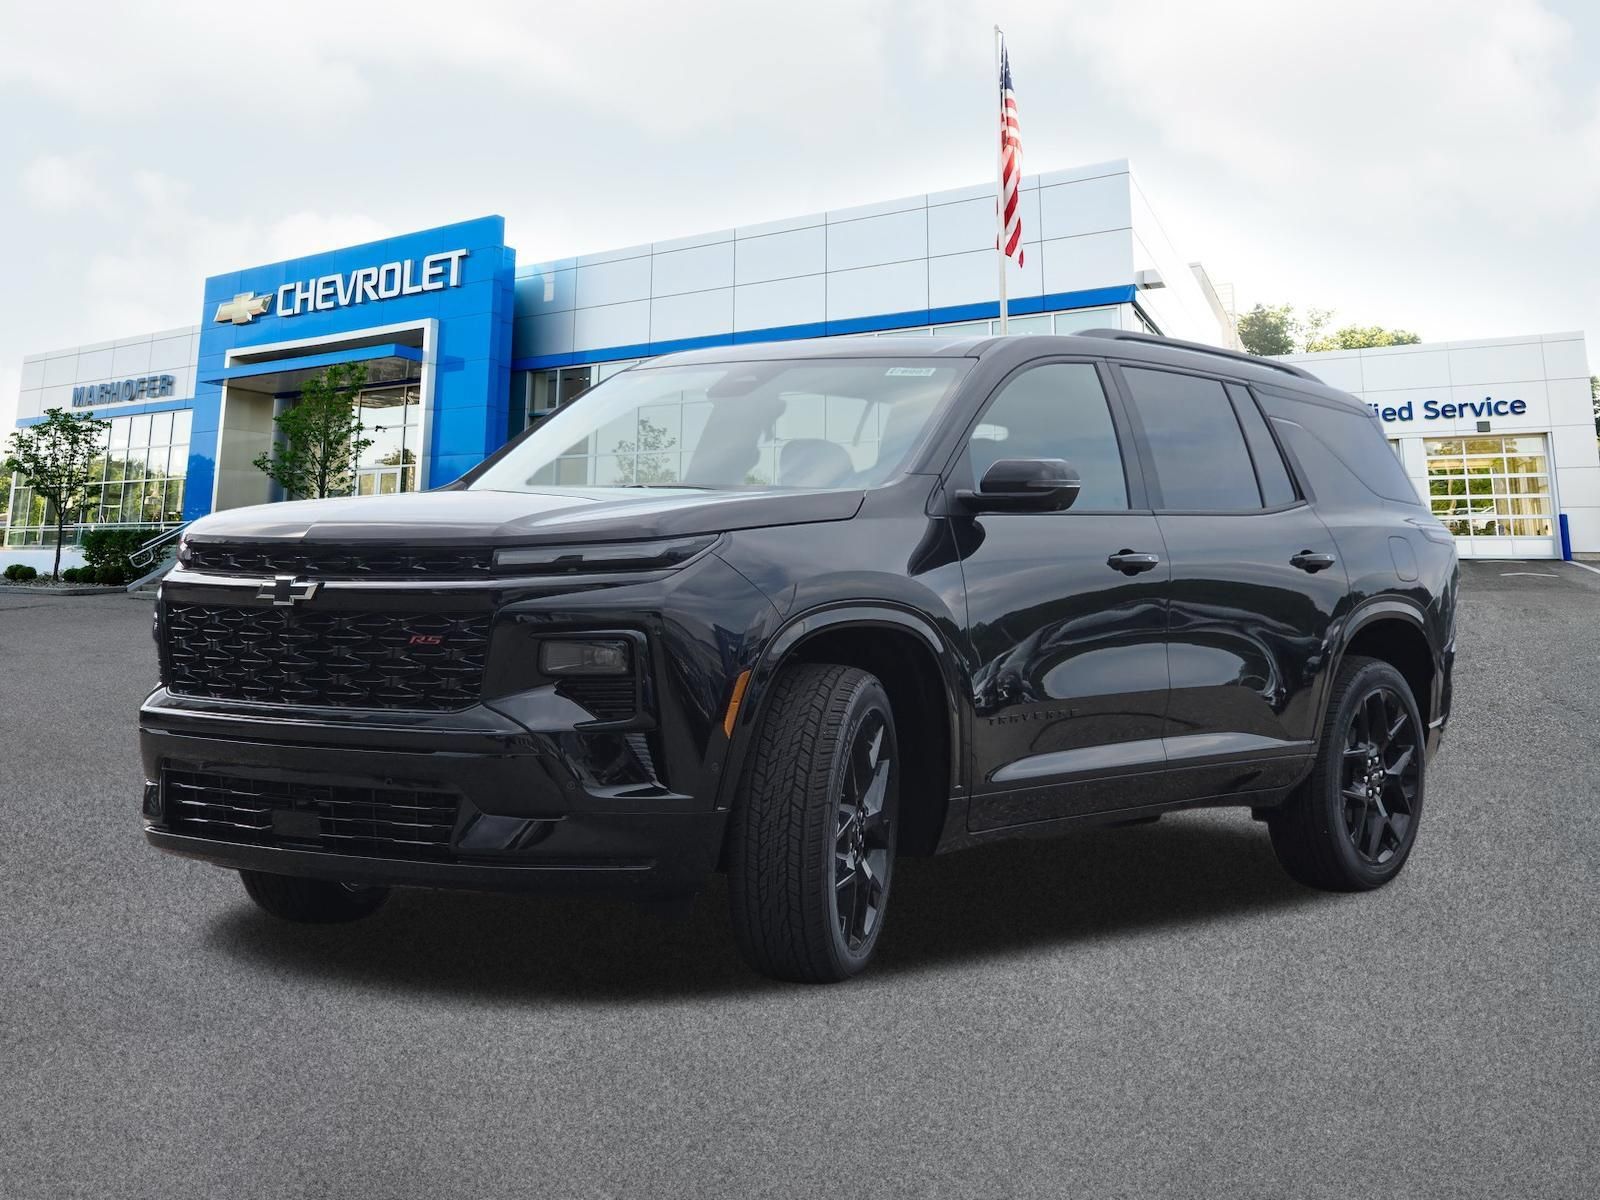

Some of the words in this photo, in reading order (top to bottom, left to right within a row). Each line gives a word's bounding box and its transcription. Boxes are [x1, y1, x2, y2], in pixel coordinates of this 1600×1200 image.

[277, 248, 470, 317] CHEVROLET
[72, 375, 175, 407] MARHOFER
[1367, 401, 1413, 422] ied
[1423, 396, 1527, 420] Service
[409, 635, 442, 645] RS
